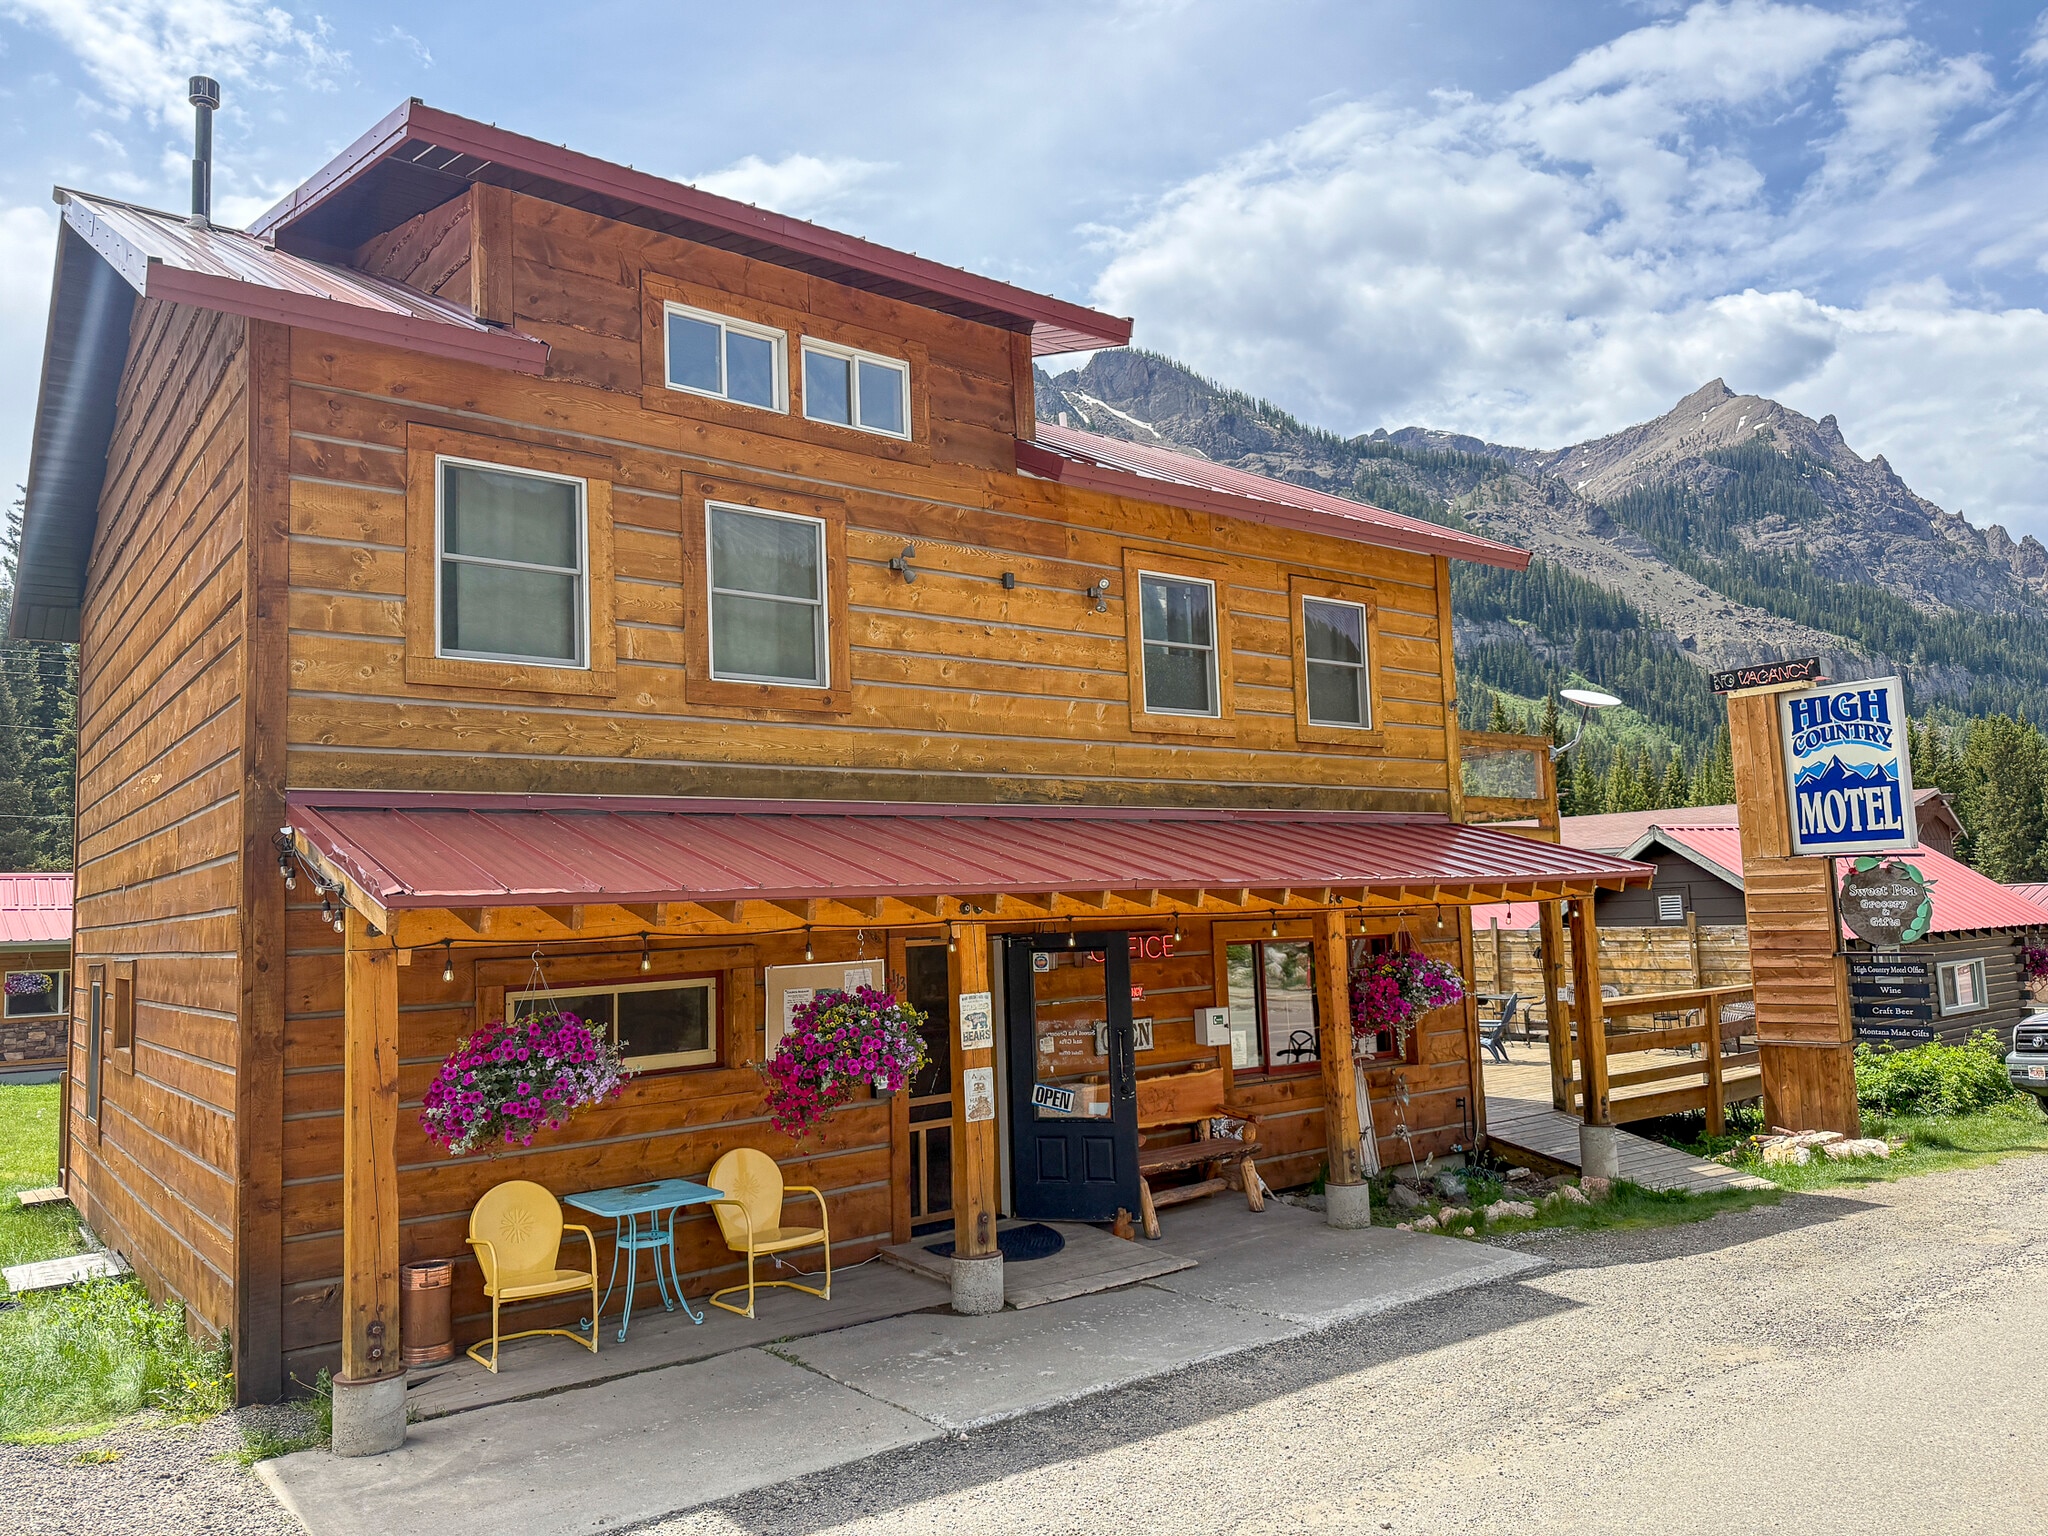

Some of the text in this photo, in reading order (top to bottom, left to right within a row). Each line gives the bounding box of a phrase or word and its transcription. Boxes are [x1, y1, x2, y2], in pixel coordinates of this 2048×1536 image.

[1737, 659, 1815, 685] VACANCY
[1789, 688, 1891, 737] HIGH
[1792, 723, 1893, 758] COUNTRY
[1800, 786, 1903, 835] MOTEL
[1849, 884, 1918, 897] Sweet Pea
[1860, 899, 1908, 910] Grocery
[1870, 917, 1901, 927] Gifts
[1853, 966, 1925, 975] High Country Motel Office
[892, 969, 906, 992] 113
[1872, 1007, 1893, 1015] Craft
[963, 1030, 990, 1042] BEARS
[1859, 1028, 1890, 1036] Montana
[1911, 1030, 1930, 1038] Gifts
[1035, 1086, 1071, 1110] OPEN
